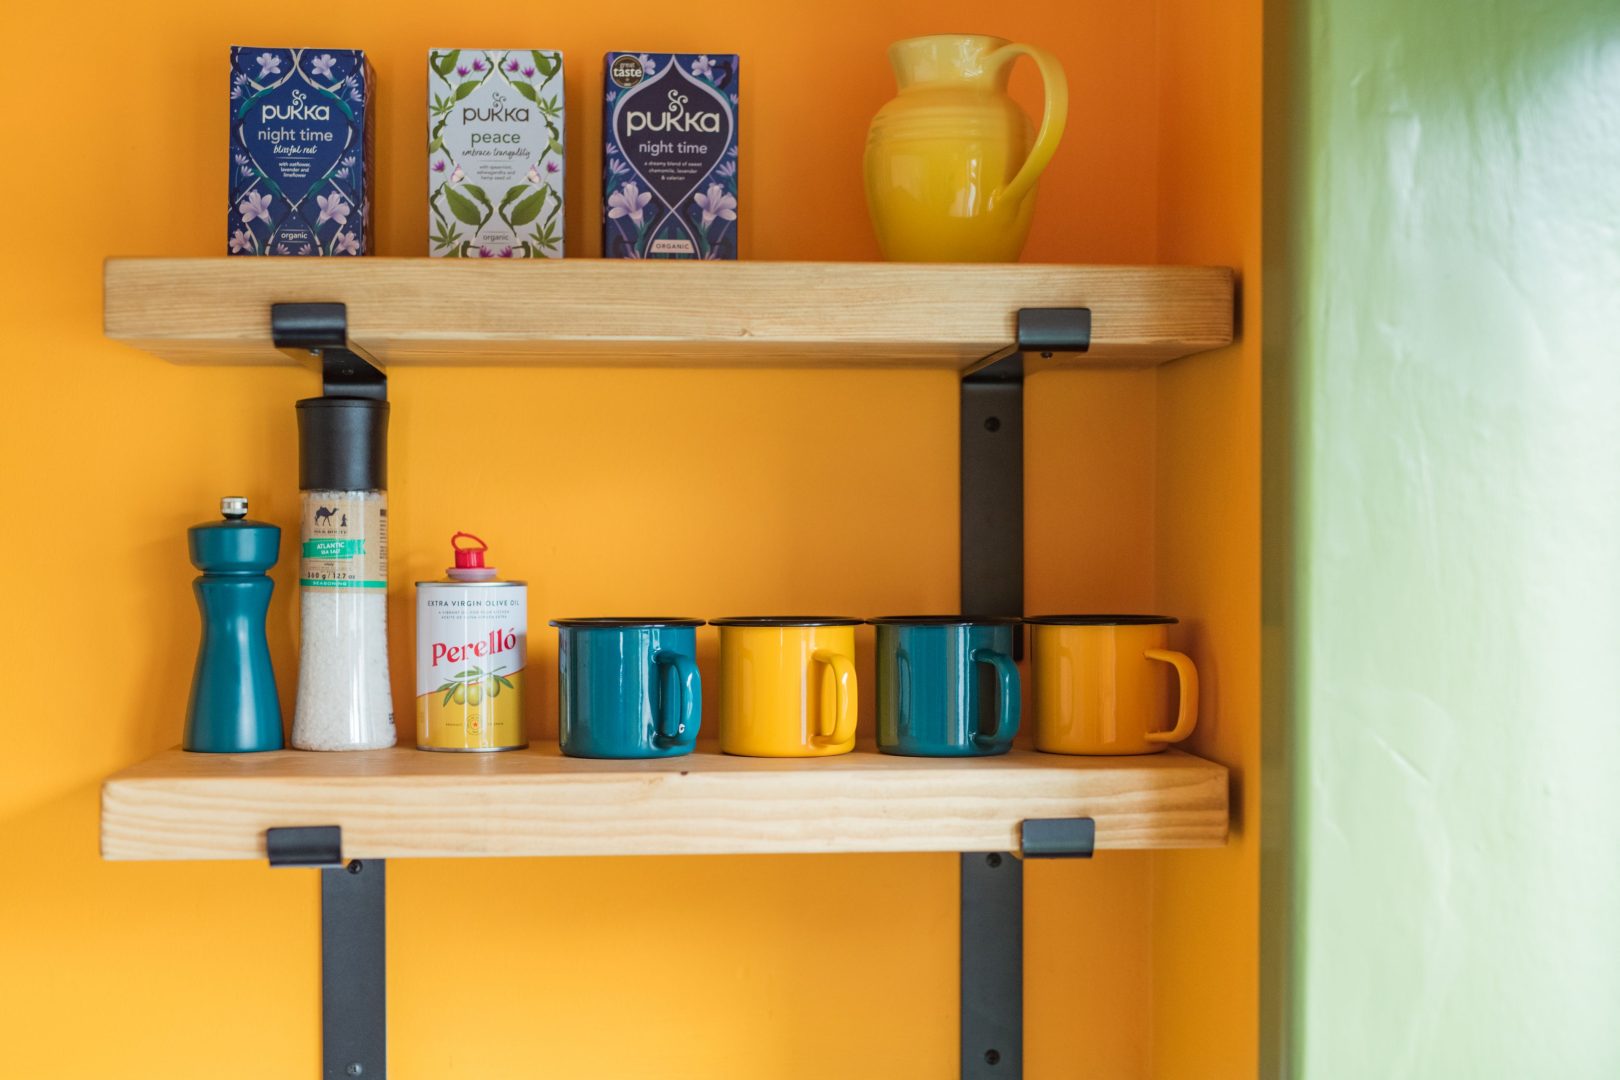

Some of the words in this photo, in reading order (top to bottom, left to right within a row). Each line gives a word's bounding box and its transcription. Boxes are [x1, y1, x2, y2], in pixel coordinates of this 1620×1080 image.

[613, 68, 642, 77] taste
[262, 89, 330, 124] pukka
[463, 92, 530, 125] pukka
[626, 89, 720, 137] pukka
[258, 126, 296, 144] night
[299, 128, 333, 141] time
[471, 132, 521, 148] peace
[273, 145, 302, 156] blissful
[639, 140, 674, 156] night
[677, 141, 708, 154] time
[281, 232, 308, 240] organic
[482, 233, 509, 242] organic
[316, 541, 345, 550] ATLANTIC
[485, 599, 508, 607] OLIVE
[509, 599, 520, 607] OIL
[431, 627, 517, 668] Perelló
